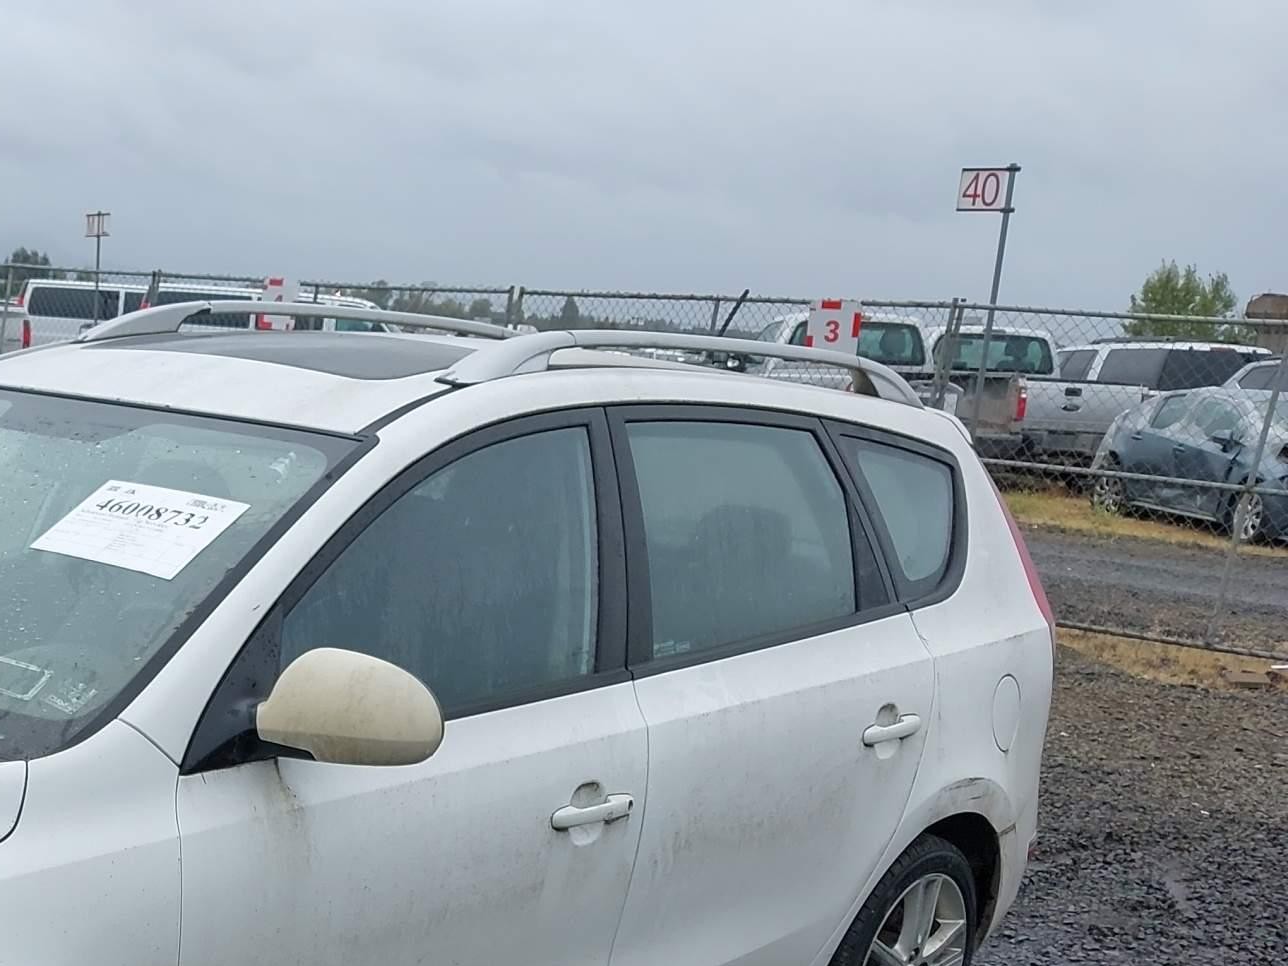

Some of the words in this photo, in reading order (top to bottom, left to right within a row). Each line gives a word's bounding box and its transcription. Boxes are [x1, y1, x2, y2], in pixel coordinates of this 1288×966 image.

[962, 172, 1000, 206] 40
[824, 320, 840, 343] 3
[96, 498, 209, 530] 46008732
